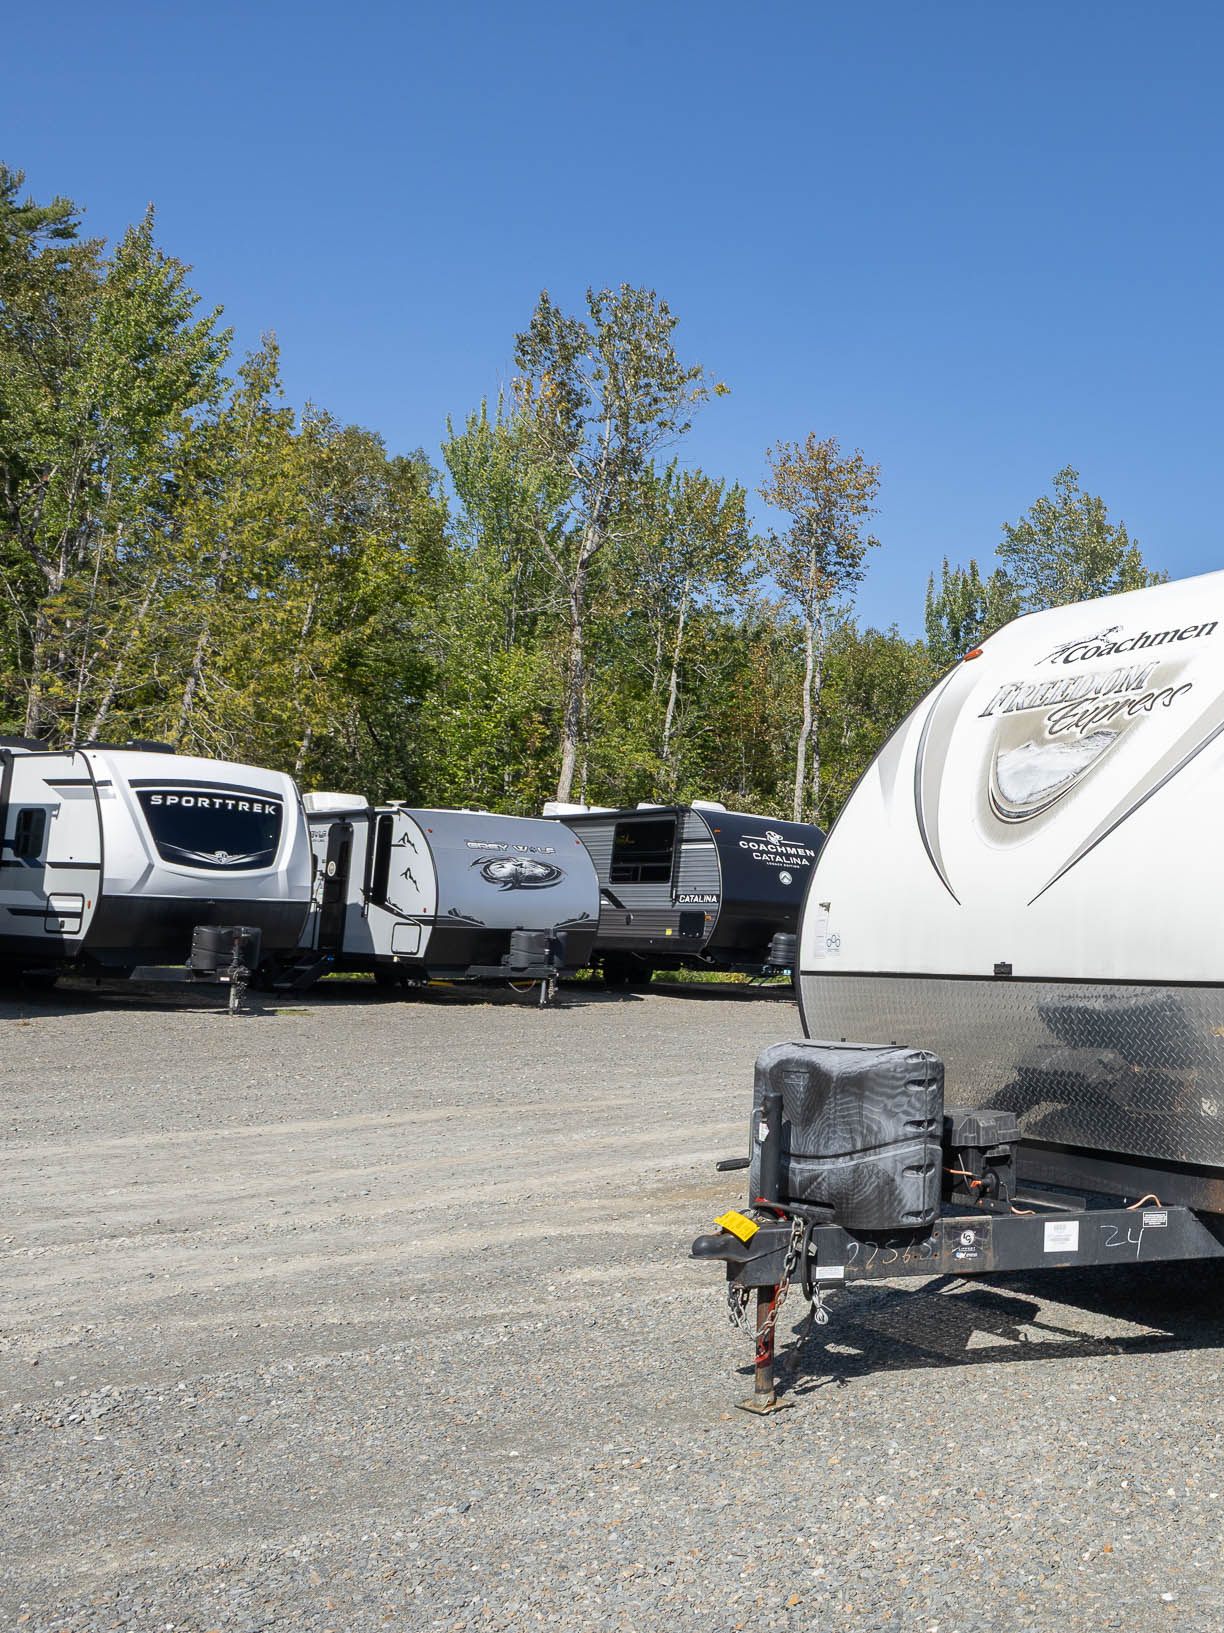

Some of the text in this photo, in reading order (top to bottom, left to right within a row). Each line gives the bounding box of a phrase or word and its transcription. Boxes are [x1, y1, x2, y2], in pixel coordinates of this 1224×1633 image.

[1061, 621, 1219, 664] Coachmen
[977, 661, 1160, 718] FREEDOM
[1047, 682, 1193, 735] Express
[150, 794, 277, 815] SPORTTREK
[465, 841, 509, 852] GREY
[739, 840, 816, 857] COACHMEN
[752, 852, 810, 866] CATALINA
[679, 894, 718, 903] CATALINA
[1099, 1225, 1145, 1261] 24
